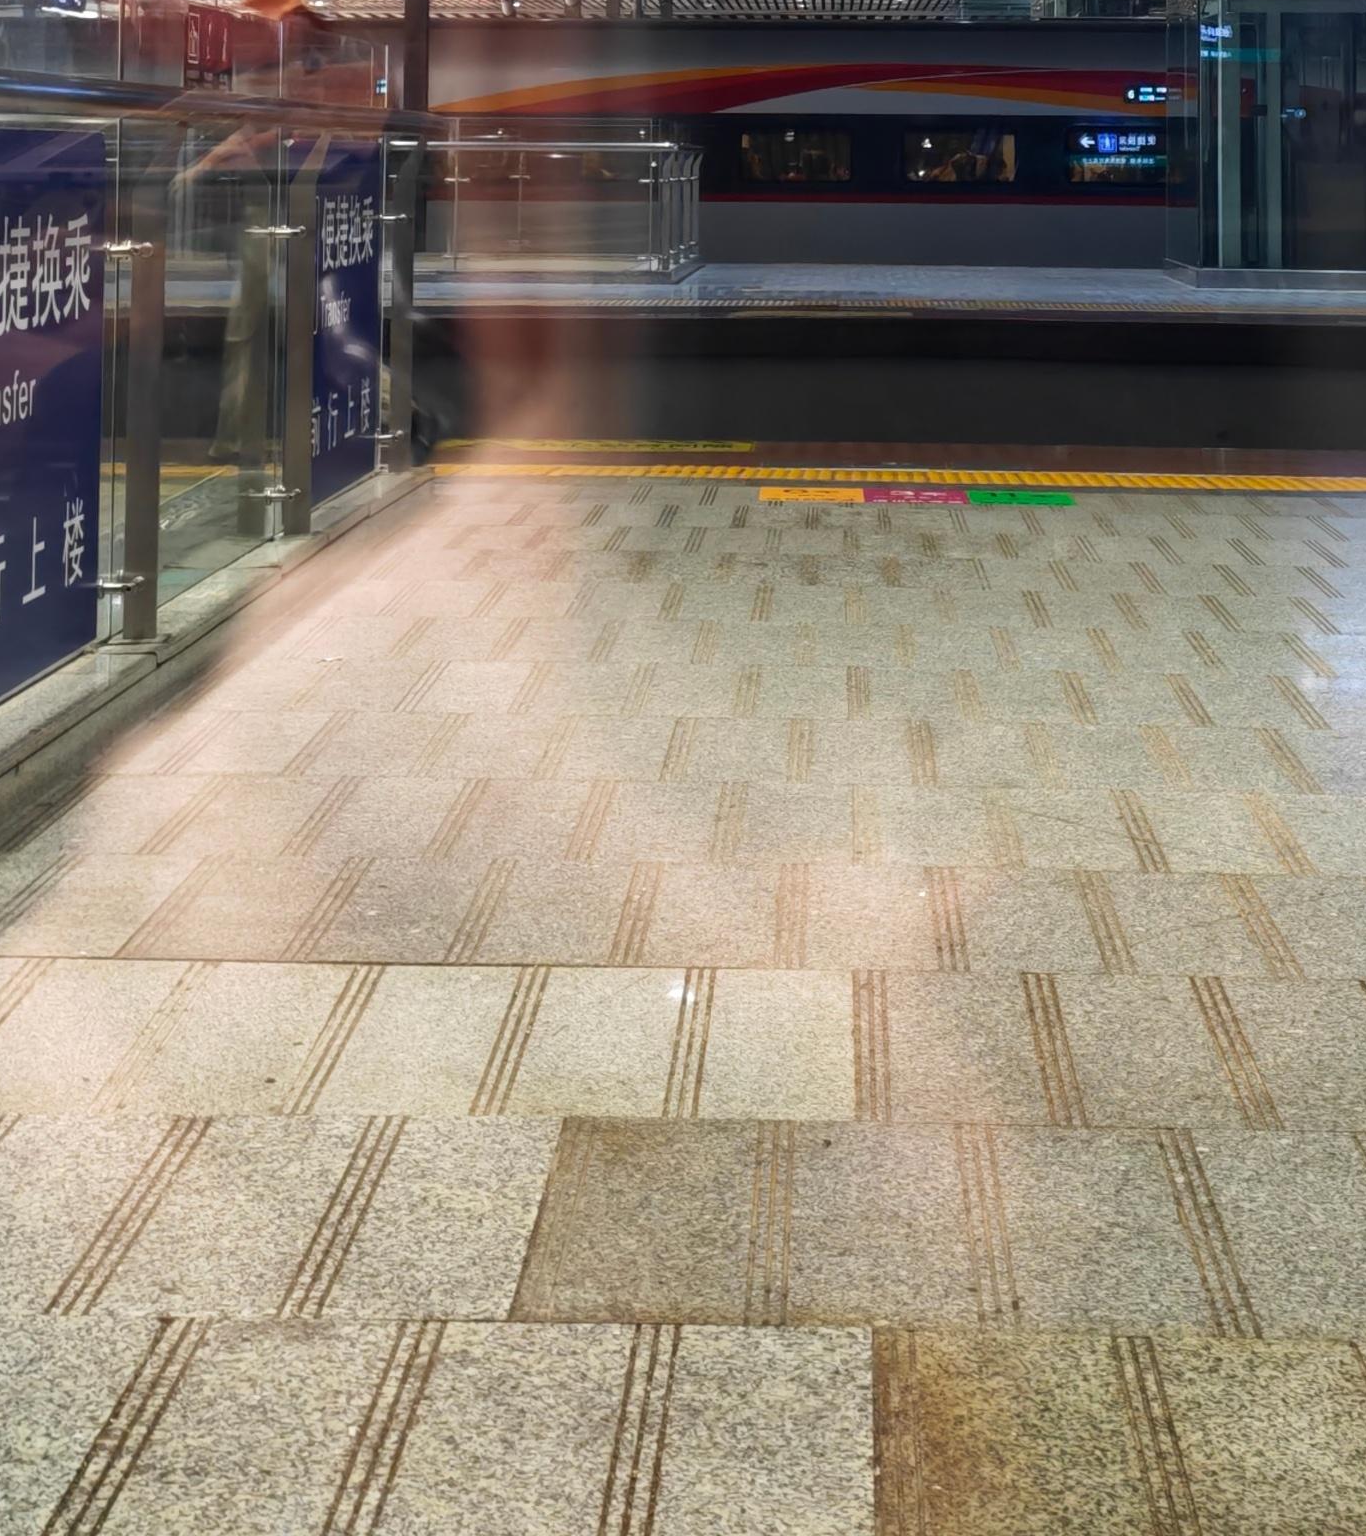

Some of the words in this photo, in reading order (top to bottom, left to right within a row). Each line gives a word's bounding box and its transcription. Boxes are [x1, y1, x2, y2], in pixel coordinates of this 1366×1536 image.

[322, 195, 374, 272] 便捷换乘
[320, 290, 351, 330] Transfer
